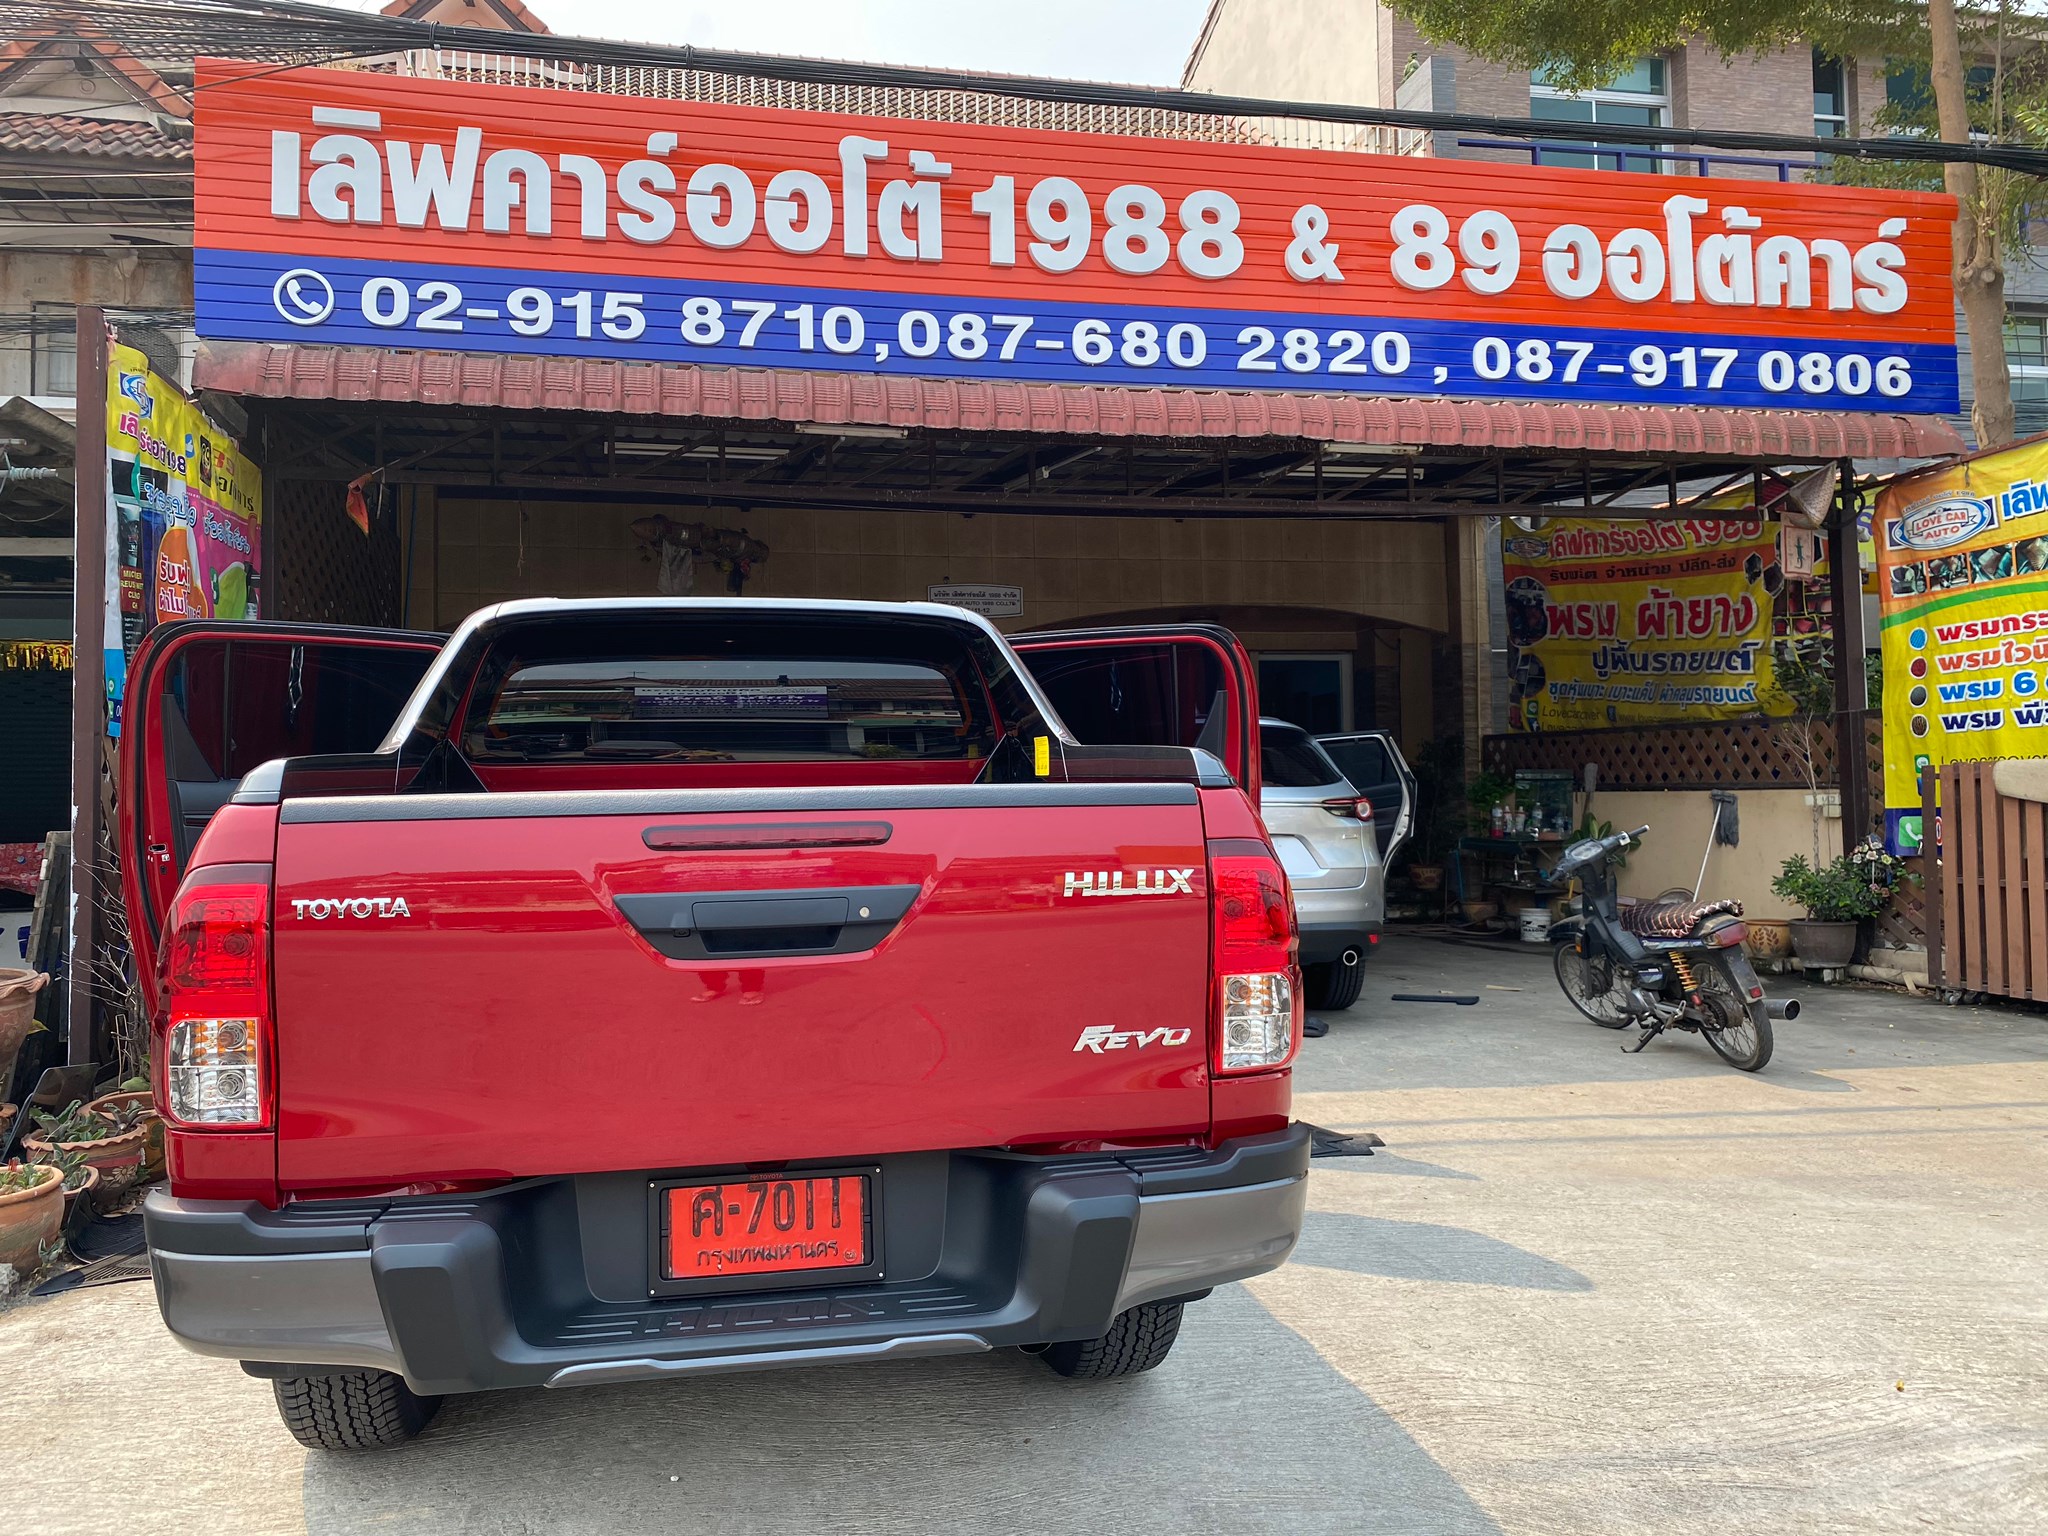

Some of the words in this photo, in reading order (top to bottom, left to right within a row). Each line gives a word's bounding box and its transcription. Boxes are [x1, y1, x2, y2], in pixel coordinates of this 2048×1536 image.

[271, 106, 952, 264] เลิฟคาร์ออโต้
[972, 174, 1245, 281] 1988
[1284, 203, 1346, 284] &
[1391, 204, 1521, 297] 89
[1542, 195, 1908, 316] ออโต้คาร์
[360, 277, 648, 343] 02-915
[1236, 326, 1411, 375] 2820
[1472, 336, 1739, 392] 087-917
[1758, 350, 1913, 398] 0806
[1915, 515, 1942, 531] LOVE
[1945, 510, 1967, 523] CAR
[1924, 525, 1961, 540] AUTO
[1606, 563, 1672, 580] จำหน่าย
[1545, 602, 1617, 637] พรม
[1637, 587, 1755, 637] ผ้ายาง
[1939, 679, 2002, 701] พรม
[2014, 671, 2037, 694] 6
[1942, 711, 2002, 731] พรม
[1063, 868, 1195, 897] HILUX
[291, 897, 411, 920] TOYOTA
[697, 1239, 839, 1271] กรุงเทพมหานคร
